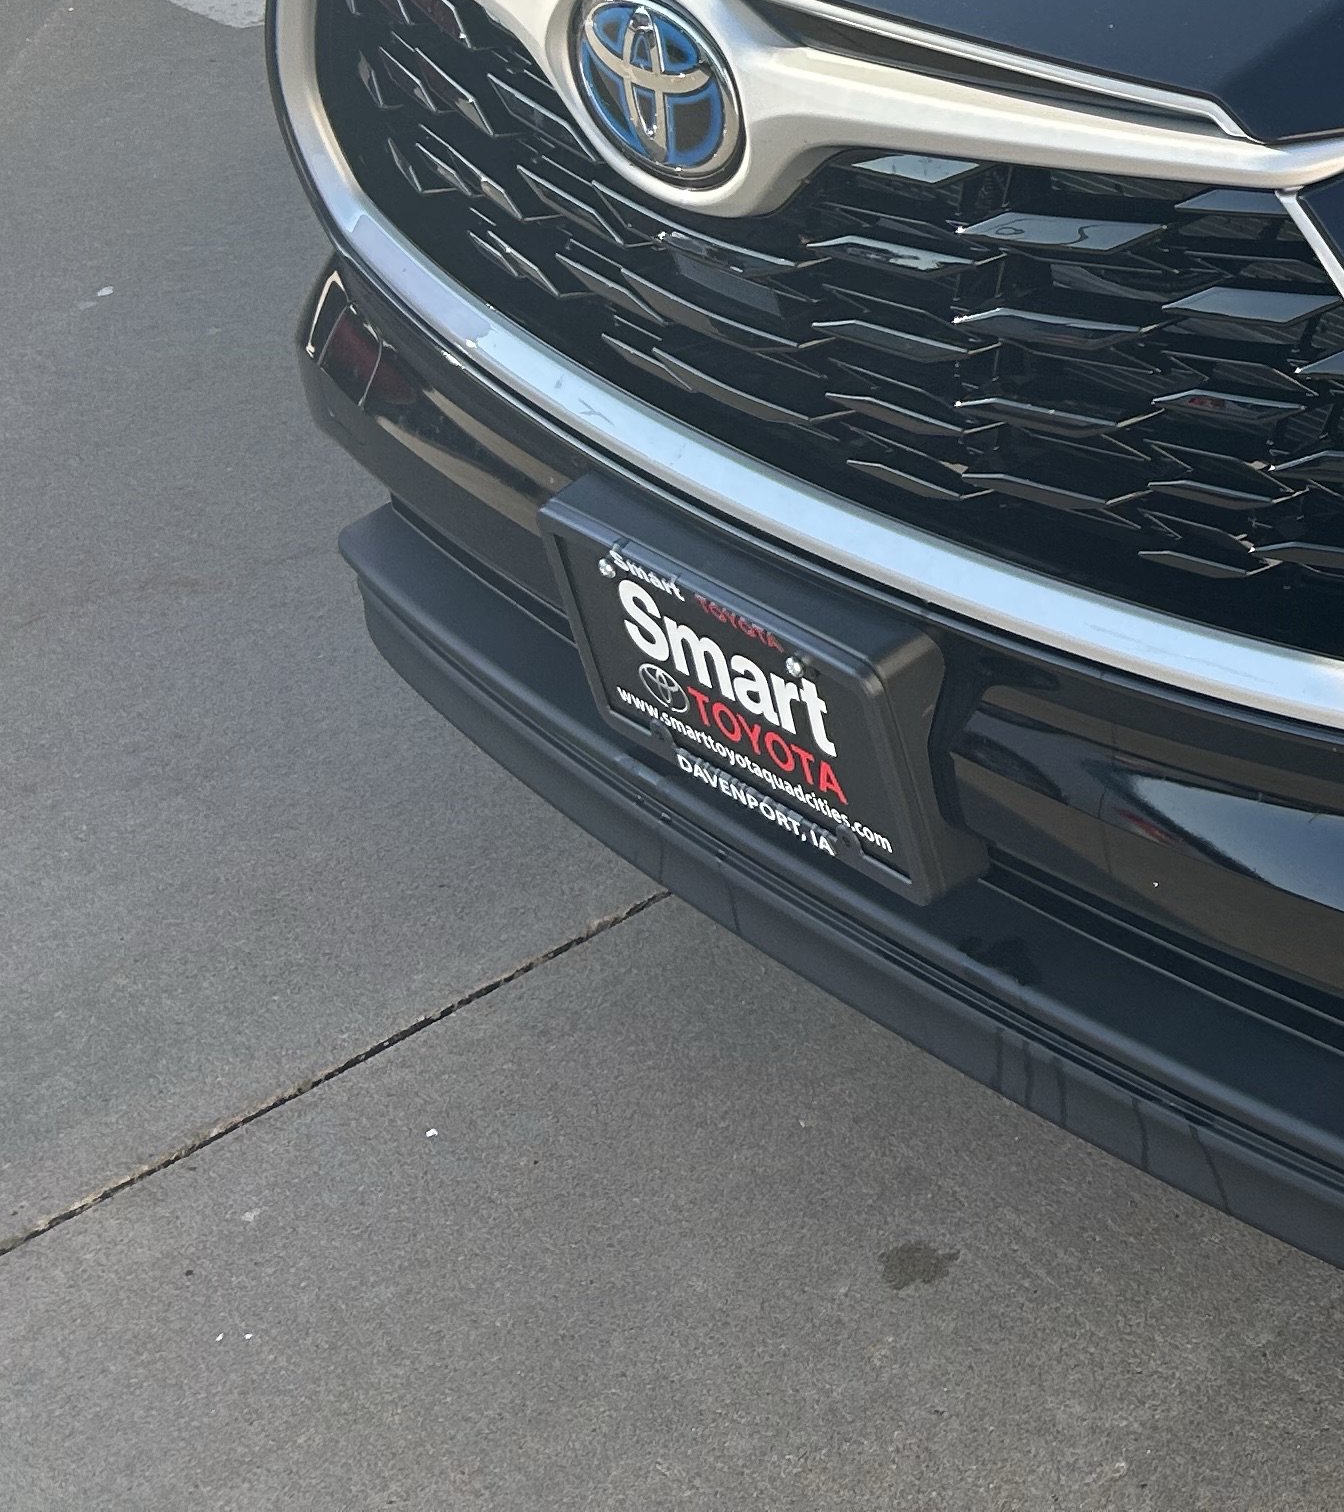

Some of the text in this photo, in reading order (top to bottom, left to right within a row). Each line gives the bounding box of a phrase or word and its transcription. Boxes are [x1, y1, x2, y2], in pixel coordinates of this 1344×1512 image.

[609, 549, 785, 653] Smart TOYOTA
[618, 579, 837, 758] Smart
[617, 687, 893, 853] www.smarttoyotaquadcities.com
[677, 754, 836, 856] DAVENPORT, IA
[687, 686, 848, 805] TOYOTA
